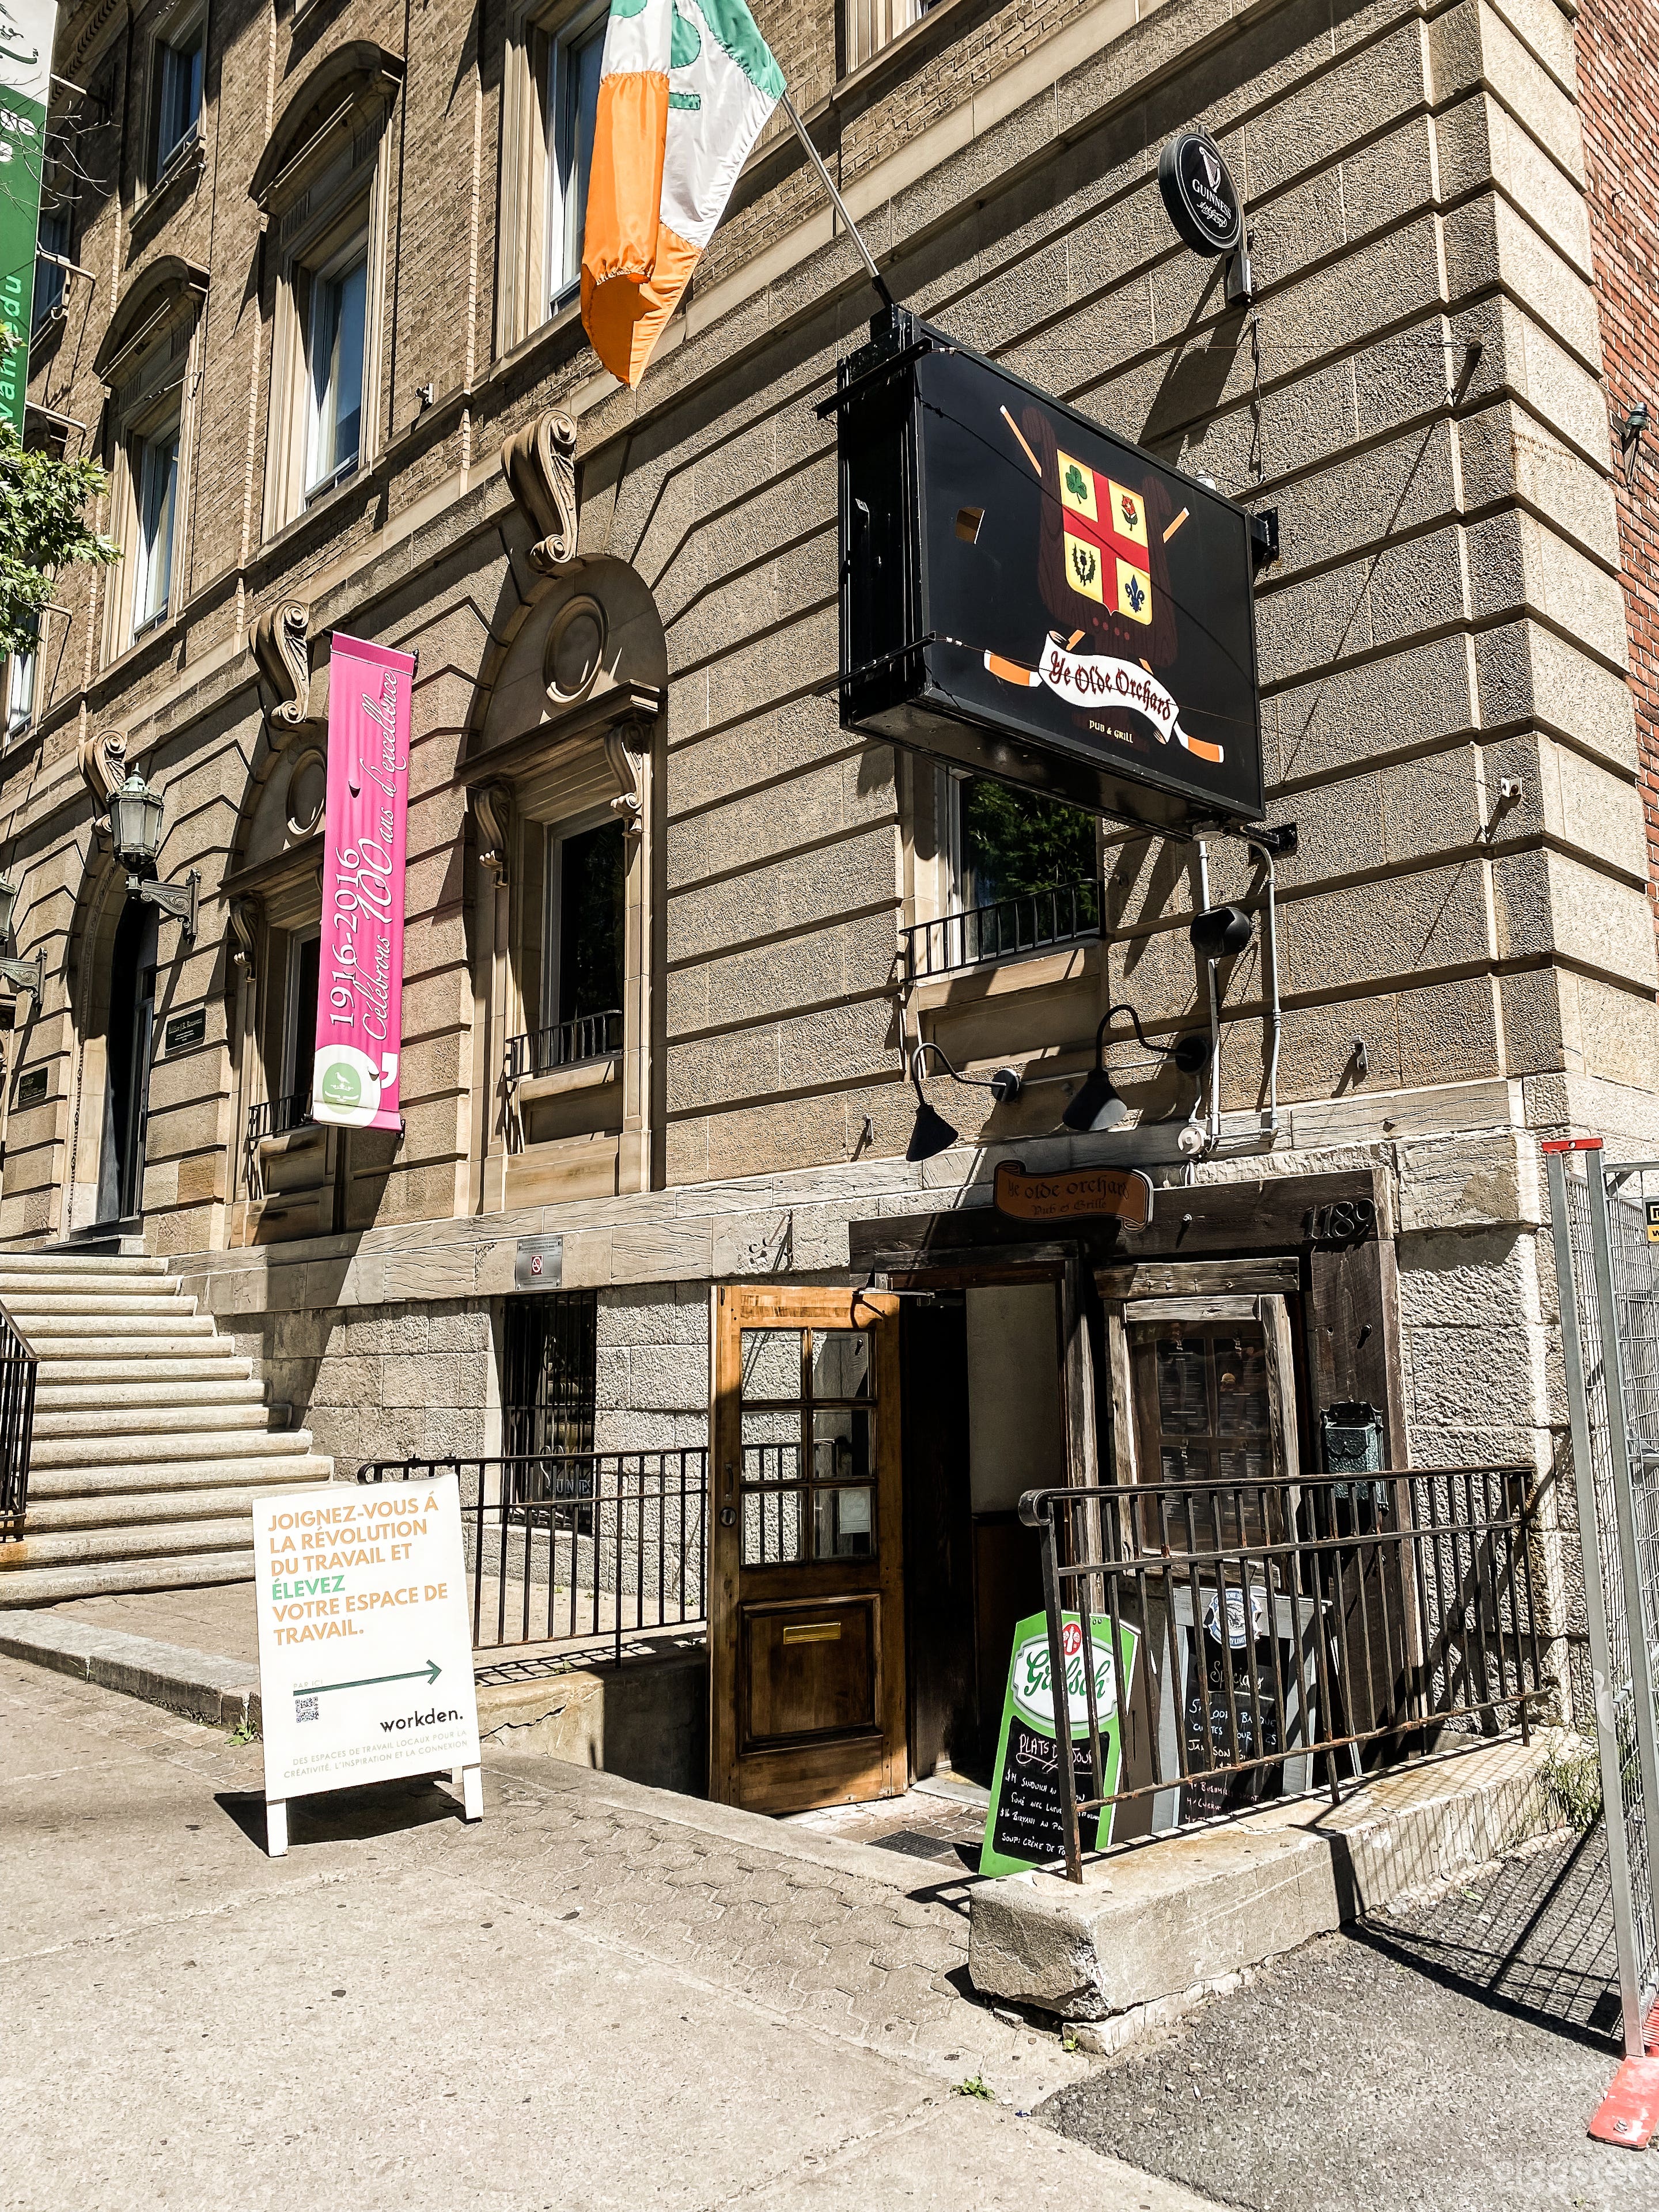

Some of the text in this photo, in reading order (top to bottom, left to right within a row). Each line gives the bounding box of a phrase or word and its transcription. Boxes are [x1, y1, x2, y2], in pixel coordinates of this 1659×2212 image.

[1192, 179, 1232, 219] GUINNESS
[1049, 651, 1172, 721] Ye Olde Orchard
[1089, 719, 1105, 732] PUB
[353, 670, 407, 1040] Célébrons 100 ans d'excellence
[329, 847, 361, 1028] 1916-2016
[1066, 1175, 1129, 1201] orchard
[1305, 1198, 1374, 1239] 1189
[268, 1498, 419, 1532] JOIGNEZ-VOUS
[270, 1518, 427, 1554] LA RÉVOLUTION
[271, 1543, 412, 1577] DU TRAVAIL ET
[272, 1574, 346, 1600] ÉLEVEZ
[272, 1583, 448, 1622] VOTRE ESPACE DE
[274, 1619, 364, 1645] TRAVAIL.
[293, 1679, 323, 1690] PAR ICI
[1024, 1649, 1111, 1699] Grlsch
[380, 1708, 463, 1733] workden.
[293, 1729, 467, 1766] DES ESPACES DE TRAVAIL LOCAUX POUR LA
[395, 1751, 403, 1759] ET
[406, 1748, 416, 1757] LA
[418, 1740, 468, 1755] CONNEXION
[1019, 1734, 1050, 1755] PLATS
[1030, 1801, 1043, 1809] AVEC
[1046, 1844, 1055, 1853] DE
